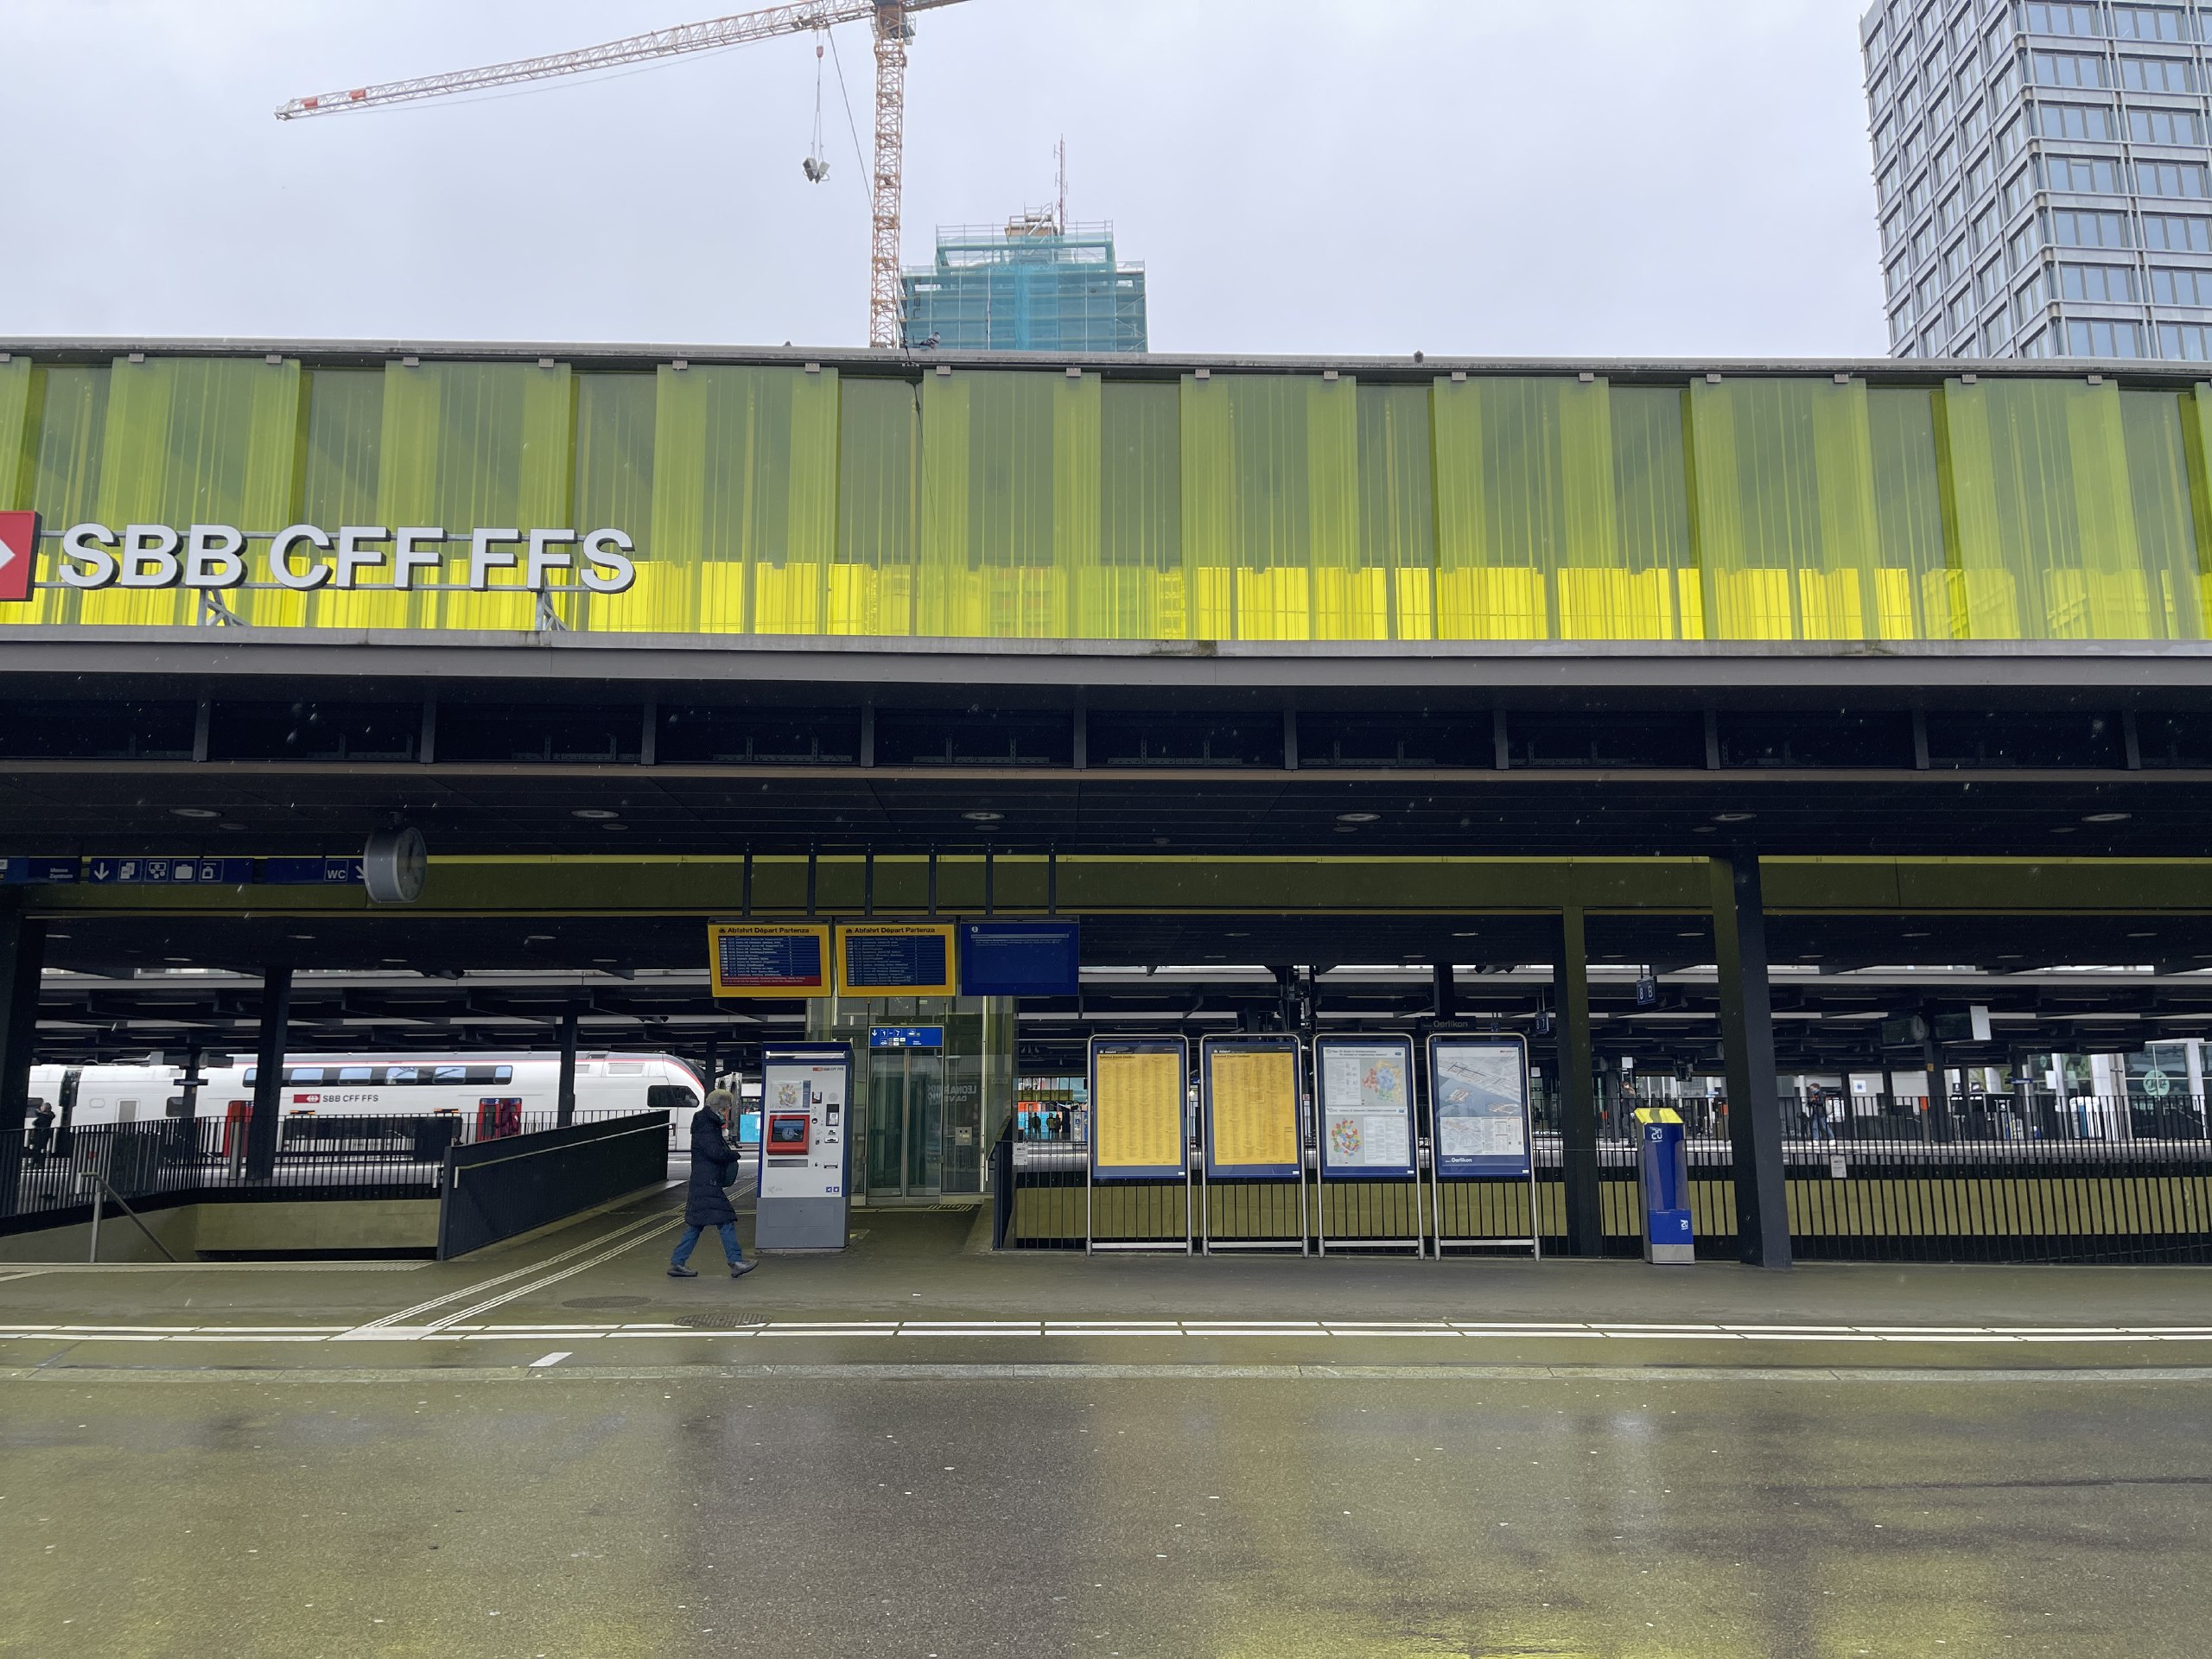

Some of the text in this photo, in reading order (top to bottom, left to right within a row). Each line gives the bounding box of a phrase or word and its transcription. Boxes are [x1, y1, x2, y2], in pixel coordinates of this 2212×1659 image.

[58, 523, 635, 594] SBB CFF FFS
[327, 869, 346, 880] WC
[1433, 1020, 1469, 1028] Oerlikon
[322, 1094, 341, 1103] SBB
